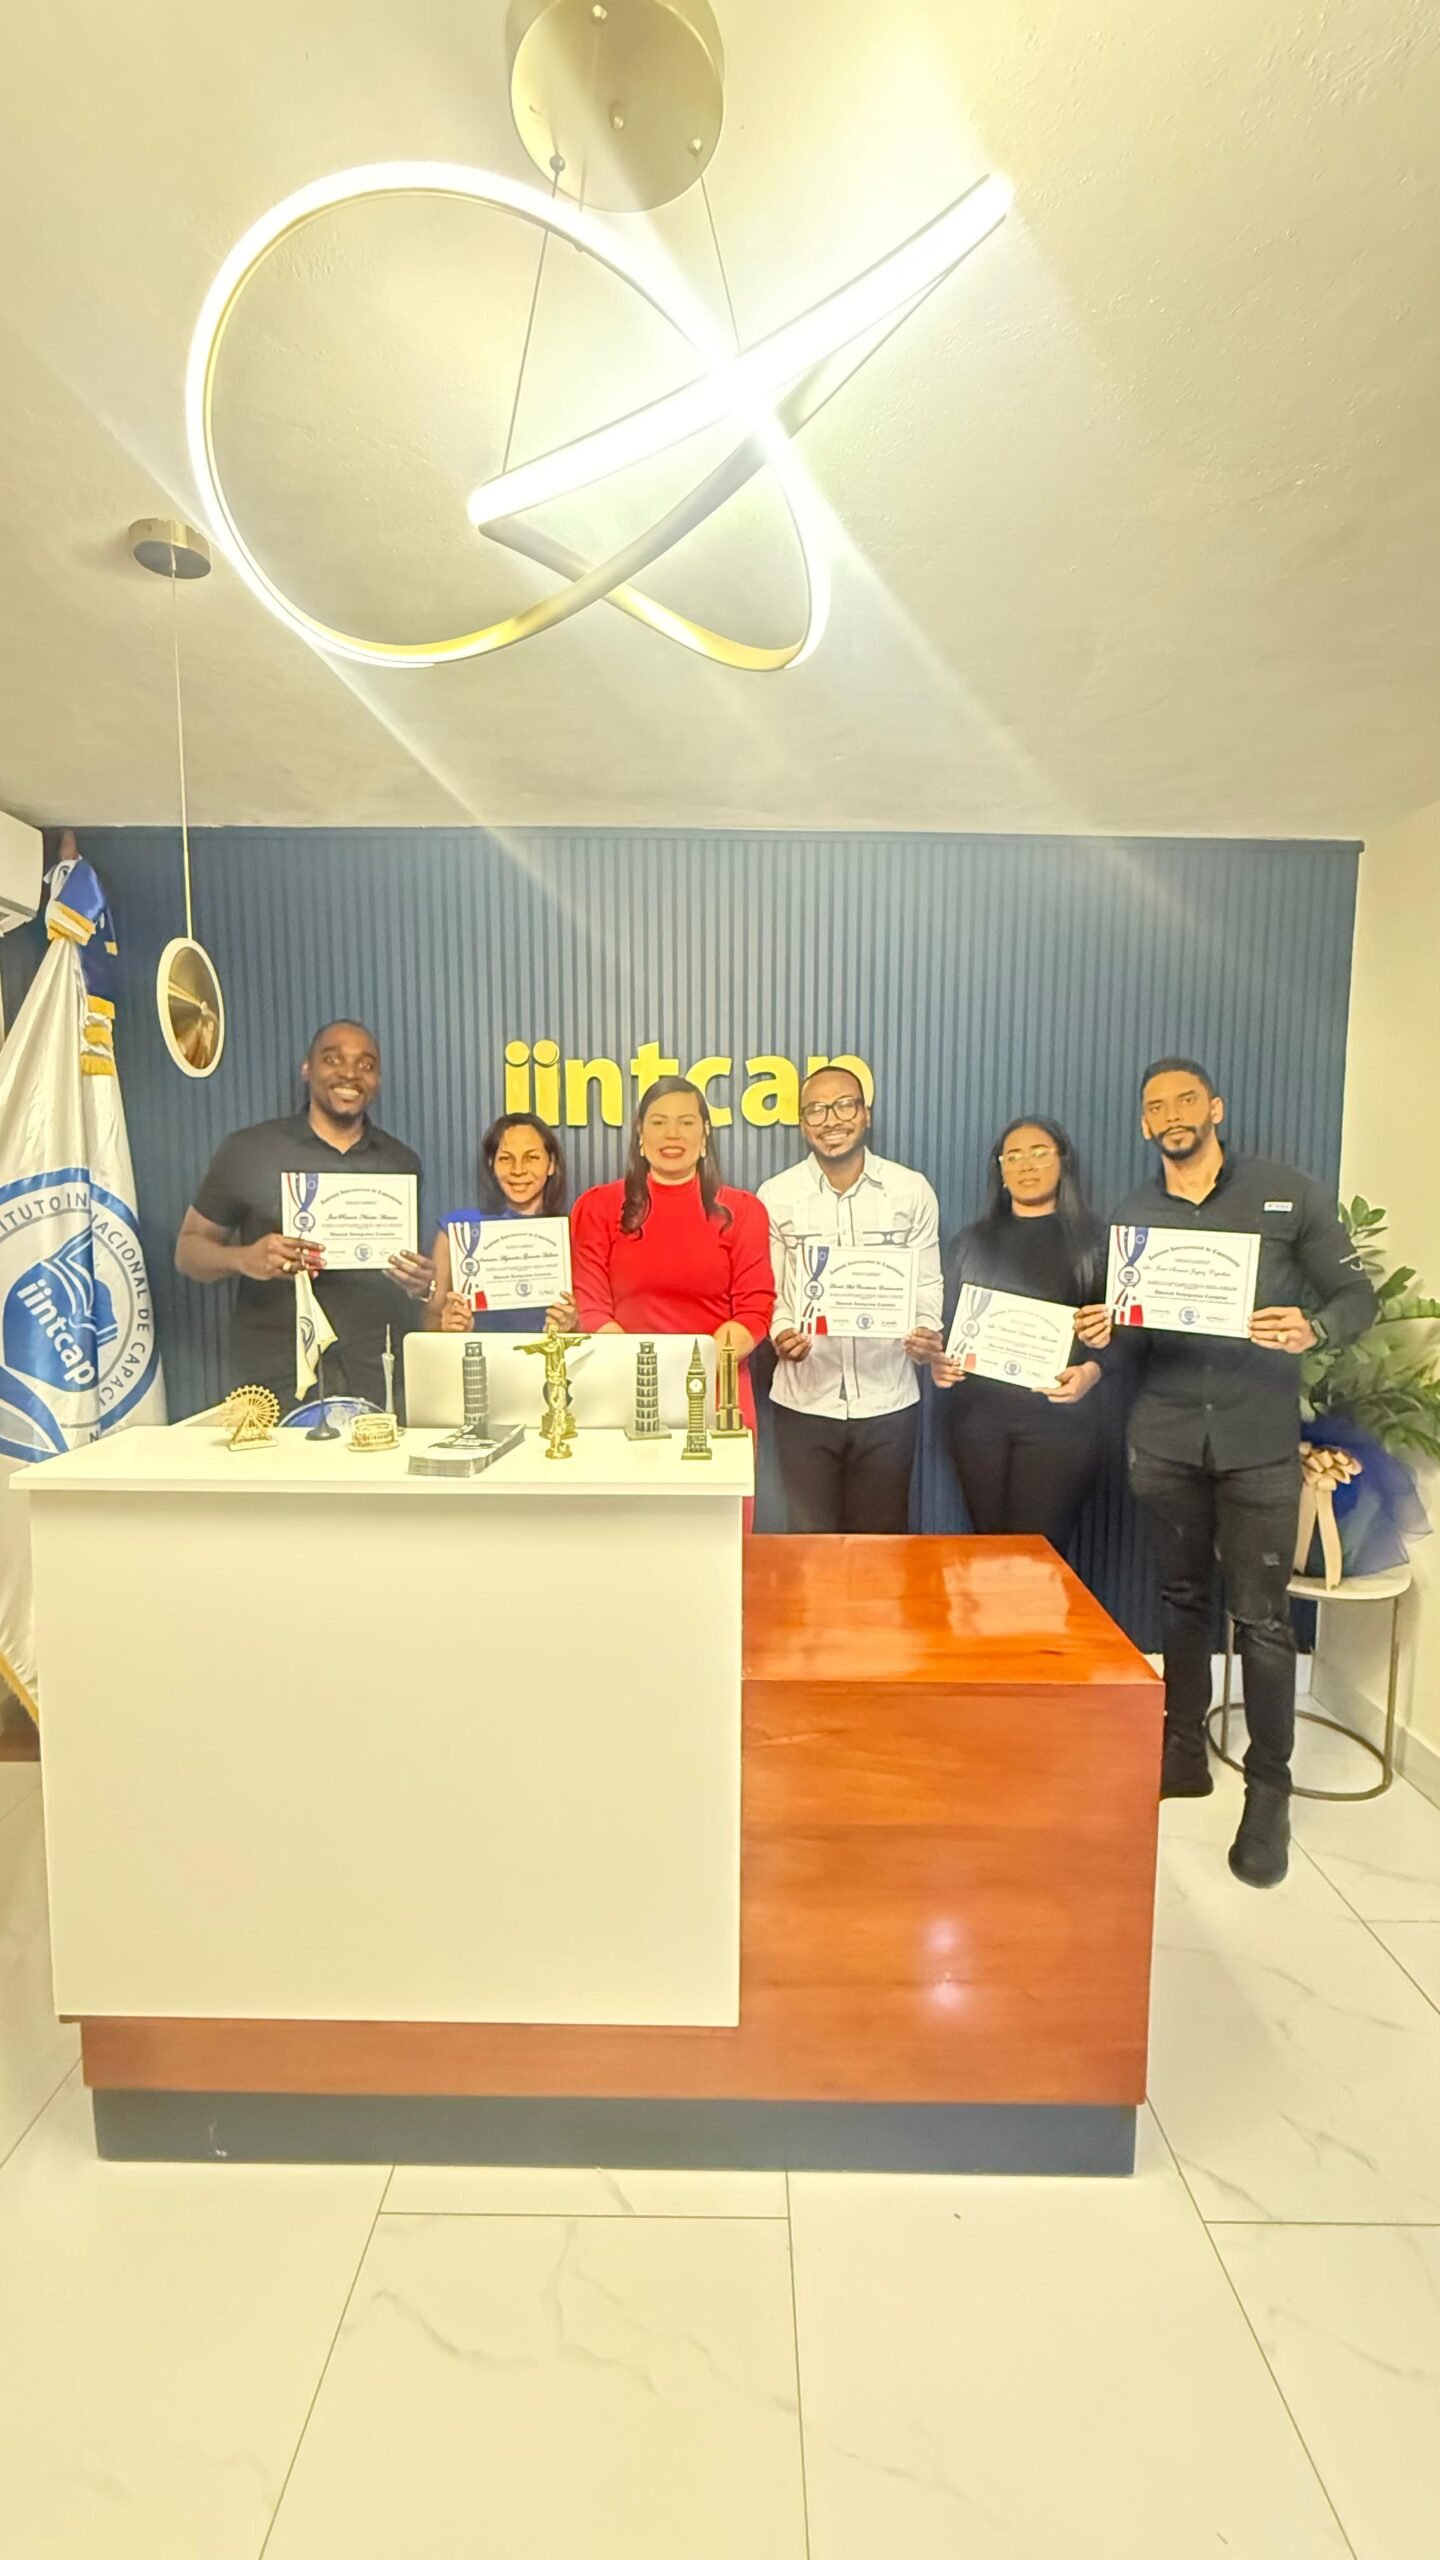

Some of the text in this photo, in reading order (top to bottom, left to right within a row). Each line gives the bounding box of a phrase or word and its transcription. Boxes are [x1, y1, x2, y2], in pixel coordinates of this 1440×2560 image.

[0, 1195, 61, 1232] ITUTO
[137, 1308, 149, 1332] DE
[16, 1278, 95, 1385] iintcap
